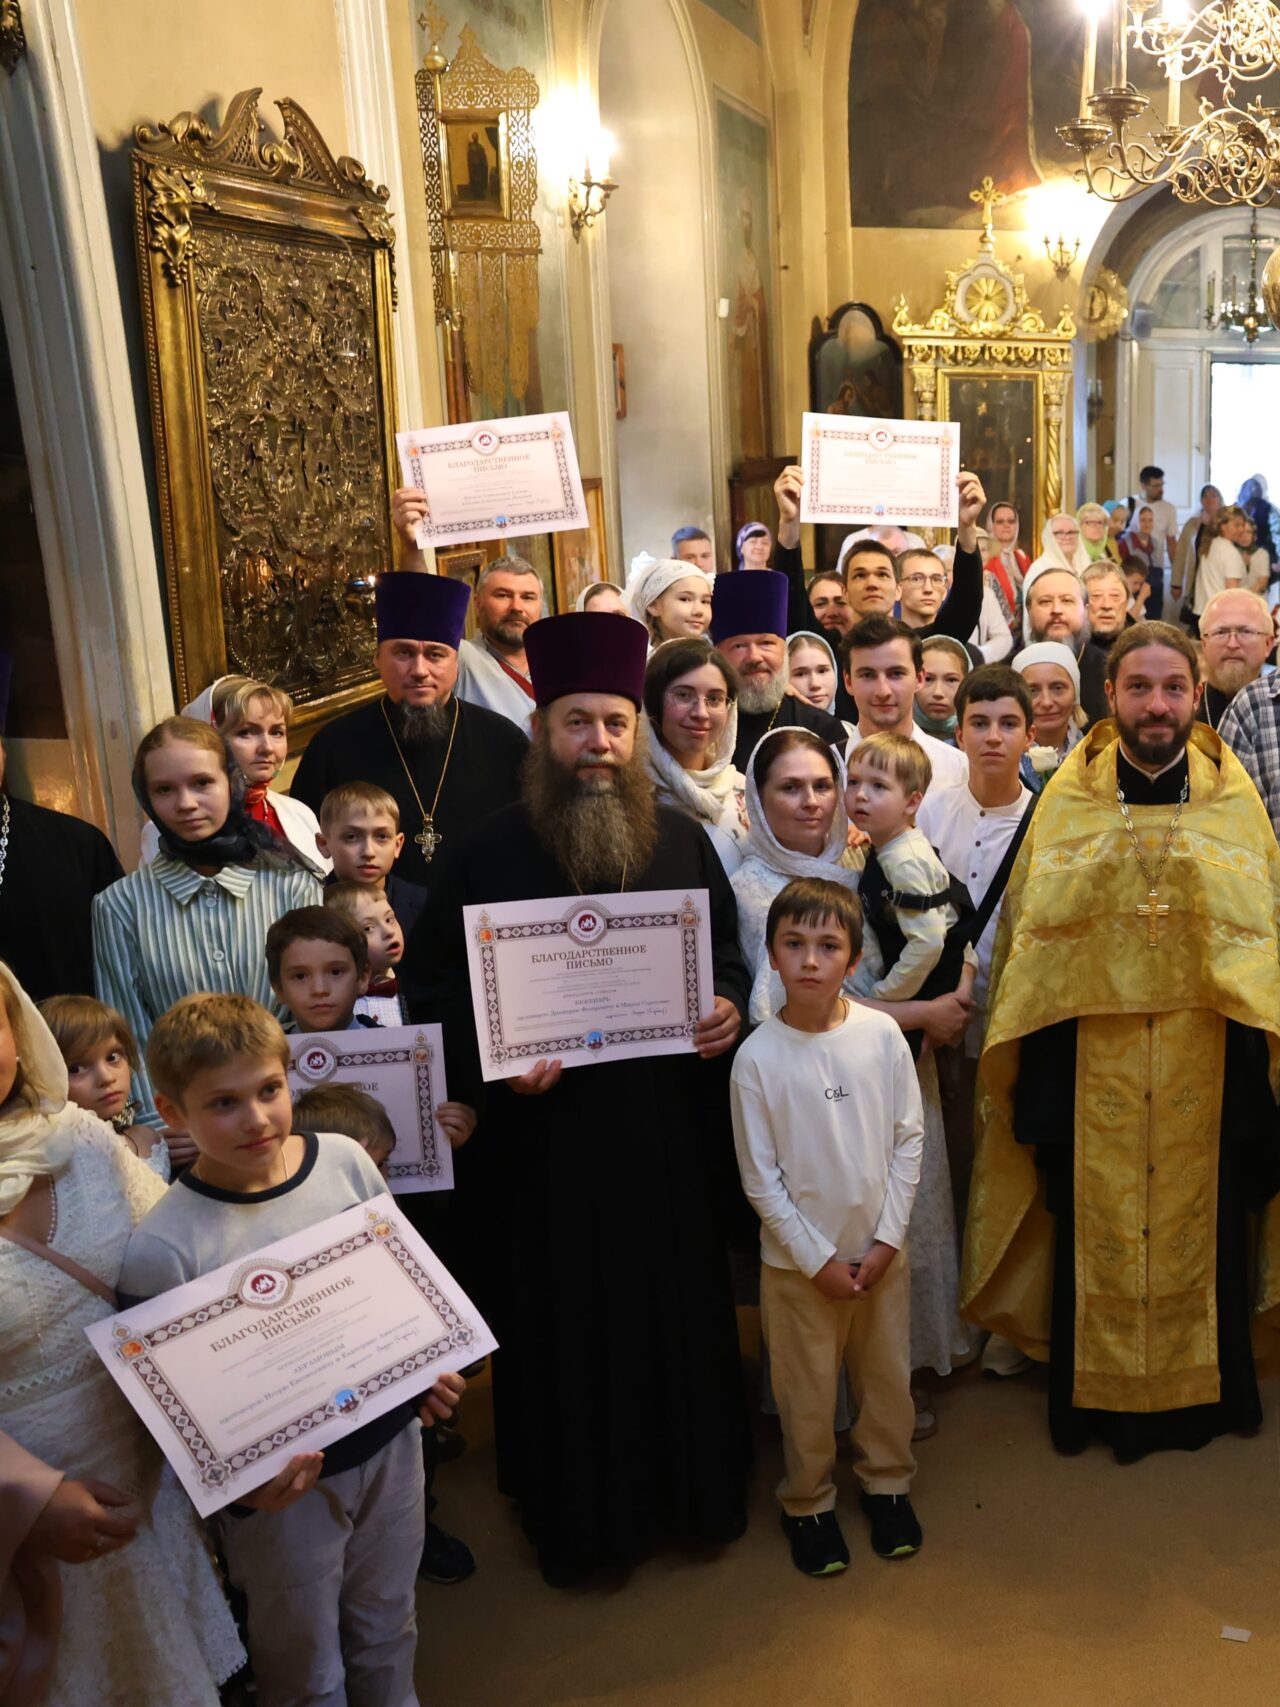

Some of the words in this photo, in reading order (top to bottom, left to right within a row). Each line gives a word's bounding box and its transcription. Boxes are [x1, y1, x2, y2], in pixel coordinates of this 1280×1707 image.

[530, 944, 647, 964] БЛАГОДАРСТВЕННОЕ
[565, 956, 613, 970] ПИСЬМО
[824, 1085, 849, 1100] C&L
[208, 1275, 356, 1353] БЛАГОДАРСТВЕННОЕ
[259, 1303, 323, 1341] ПИСЬМО
